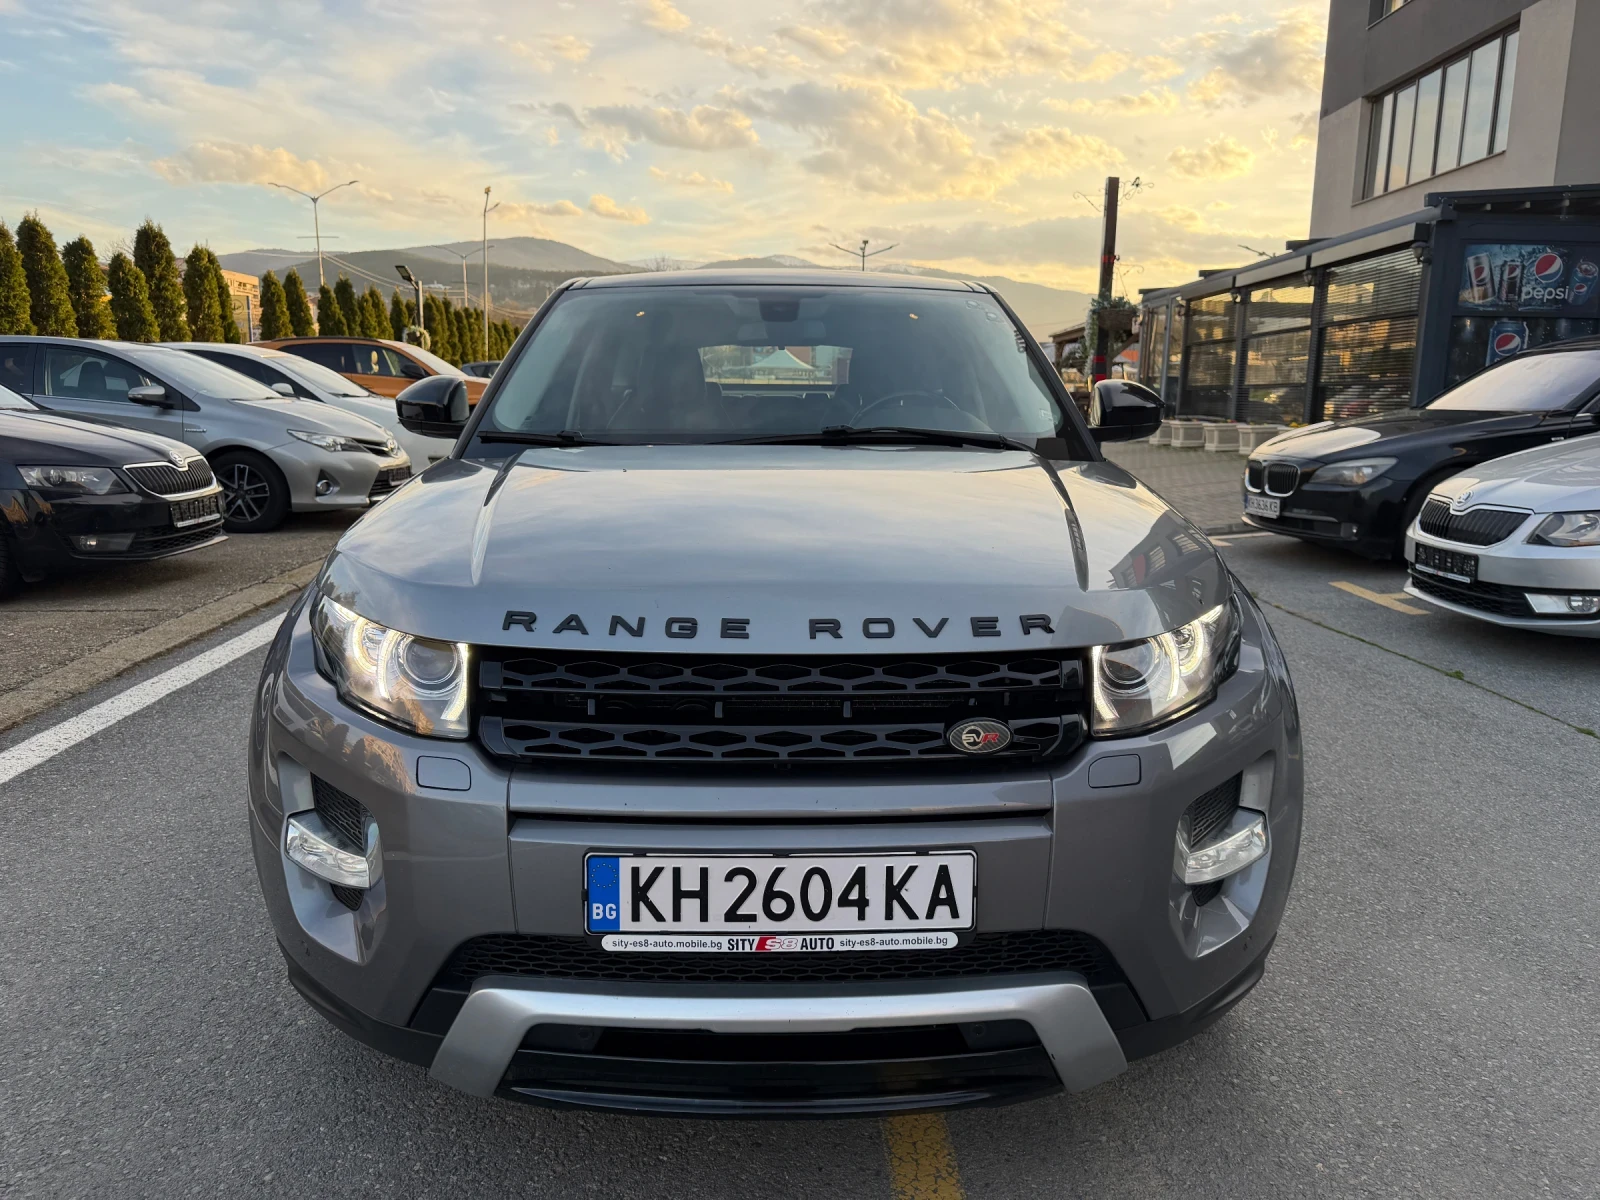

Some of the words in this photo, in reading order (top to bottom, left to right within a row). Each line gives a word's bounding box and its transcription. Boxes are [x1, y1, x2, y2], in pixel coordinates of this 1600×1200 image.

[1521, 286, 1569, 303] pepsi
[502, 610, 750, 640] RANGE
[808, 613, 1056, 640] ROVER
[592, 903, 617, 921] BG
[612, 939, 723, 950] sity-es8-auto.mobile.bg
[727, 938, 755, 951] SITY
[800, 937, 835, 950] AUTO
[839, 936, 948, 948] sity-es8-auto.mobile.bg
